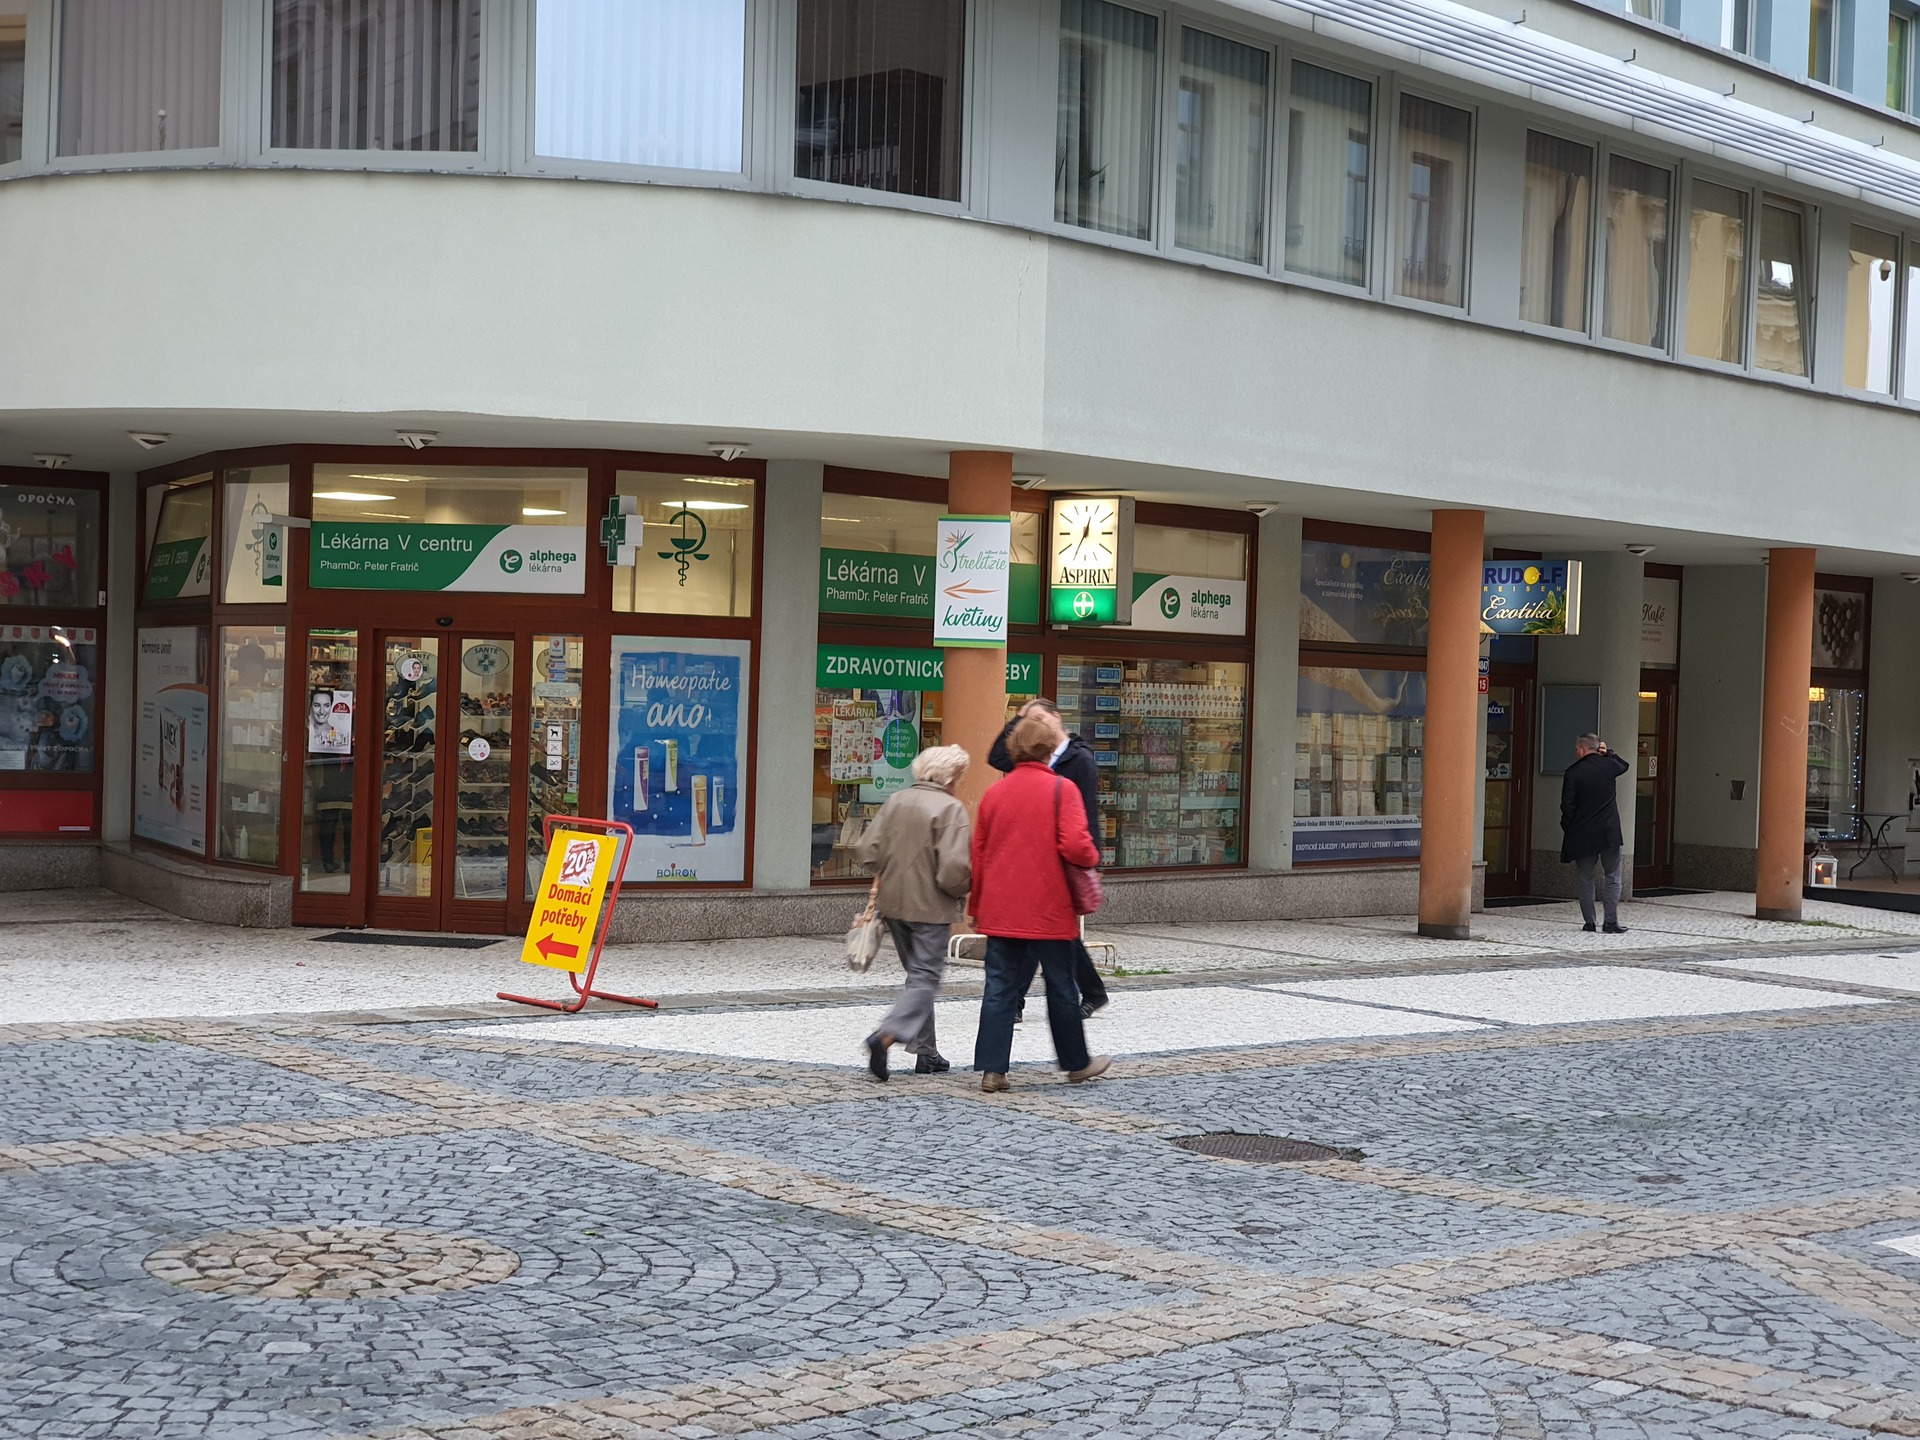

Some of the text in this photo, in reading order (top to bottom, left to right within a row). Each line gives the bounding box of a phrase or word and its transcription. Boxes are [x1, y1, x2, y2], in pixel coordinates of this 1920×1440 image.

[320, 532, 473, 552] Lékárna V centru
[320, 560, 419, 572] PharmDr. Peter Fratrič
[529, 550, 577, 564] alphega
[939, 542, 1008, 573] Strelitzie
[528, 563, 562, 573] lékárna
[827, 558, 927, 587] Lékárna V
[1484, 566, 1562, 585] RUDOLF
[826, 587, 929, 606] PharmDr. Peter Fratrič
[1191, 590, 1232, 607] alphega
[1190, 606, 1219, 620] lékárna
[1482, 594, 1562, 622] Exotika
[942, 605, 1004, 633] květiny
[826, 655, 944, 679] ZDRAVOTNICK
[631, 664, 732, 699] Homeopatie
[656, 864, 697, 878] BOIRON
[548, 883, 594, 906] Domácí
[540, 907, 587, 934] potřeby
